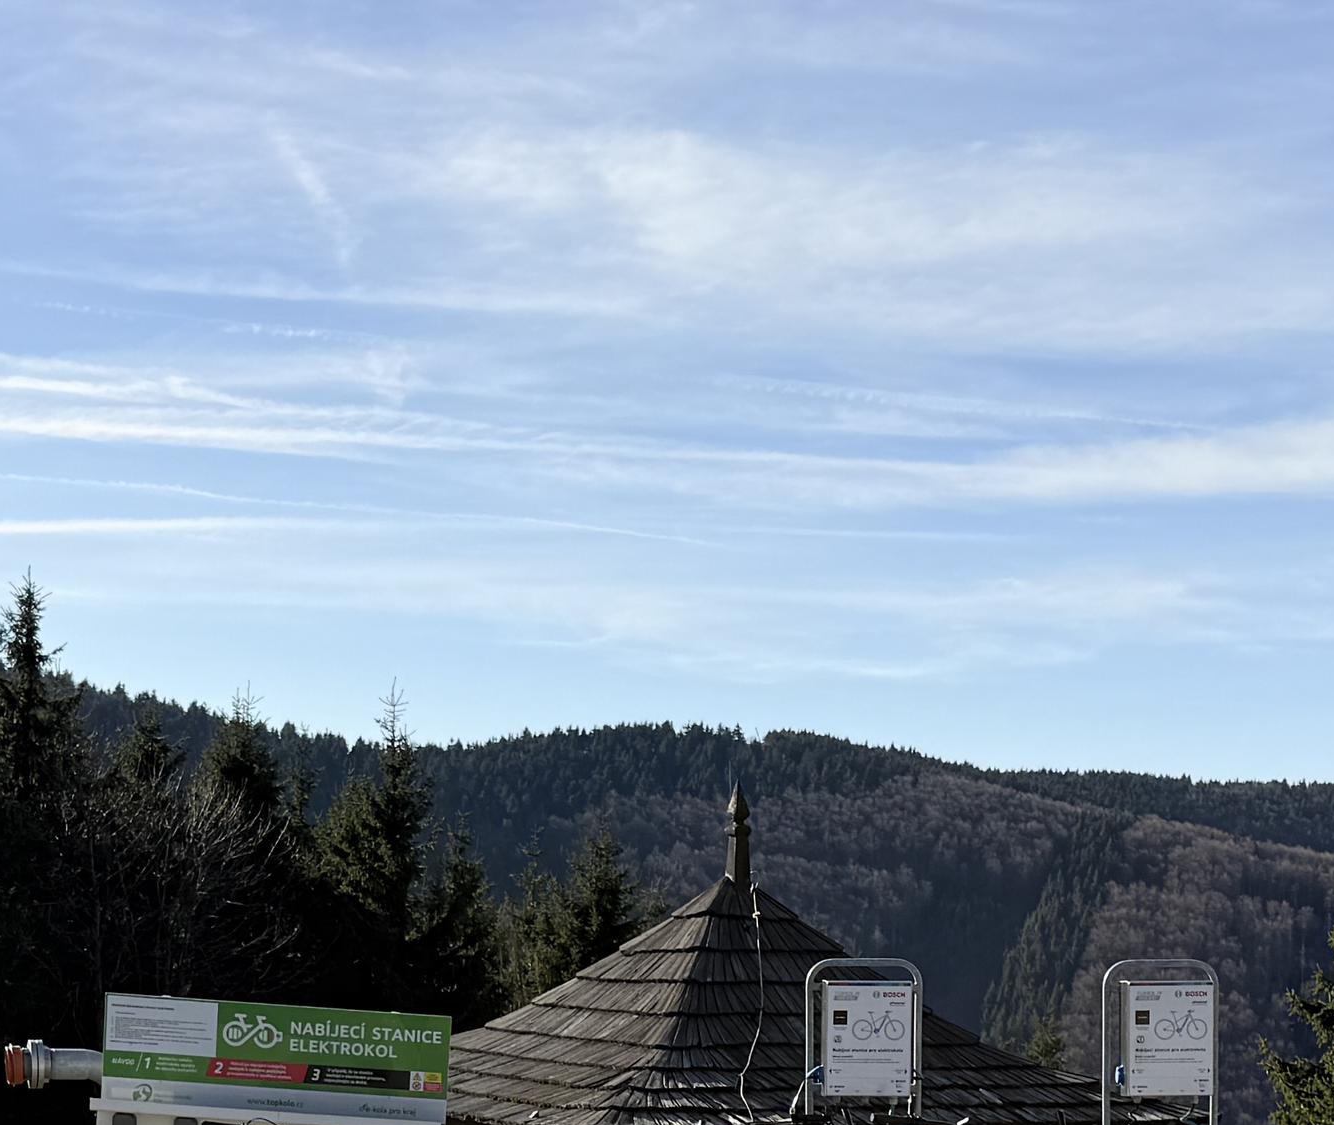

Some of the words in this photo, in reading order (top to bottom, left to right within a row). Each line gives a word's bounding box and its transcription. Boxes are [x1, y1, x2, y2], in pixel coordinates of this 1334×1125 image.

[290, 1020, 365, 1039] NABÍJECÍ
[372, 1027, 442, 1044] STANICE
[289, 1039, 397, 1058] ELEKTROKOL
[112, 1056, 135, 1066] NÁVOD
[144, 1057, 151, 1069] 1
[214, 1062, 224, 1074] 2
[311, 1068, 321, 1081] 3
